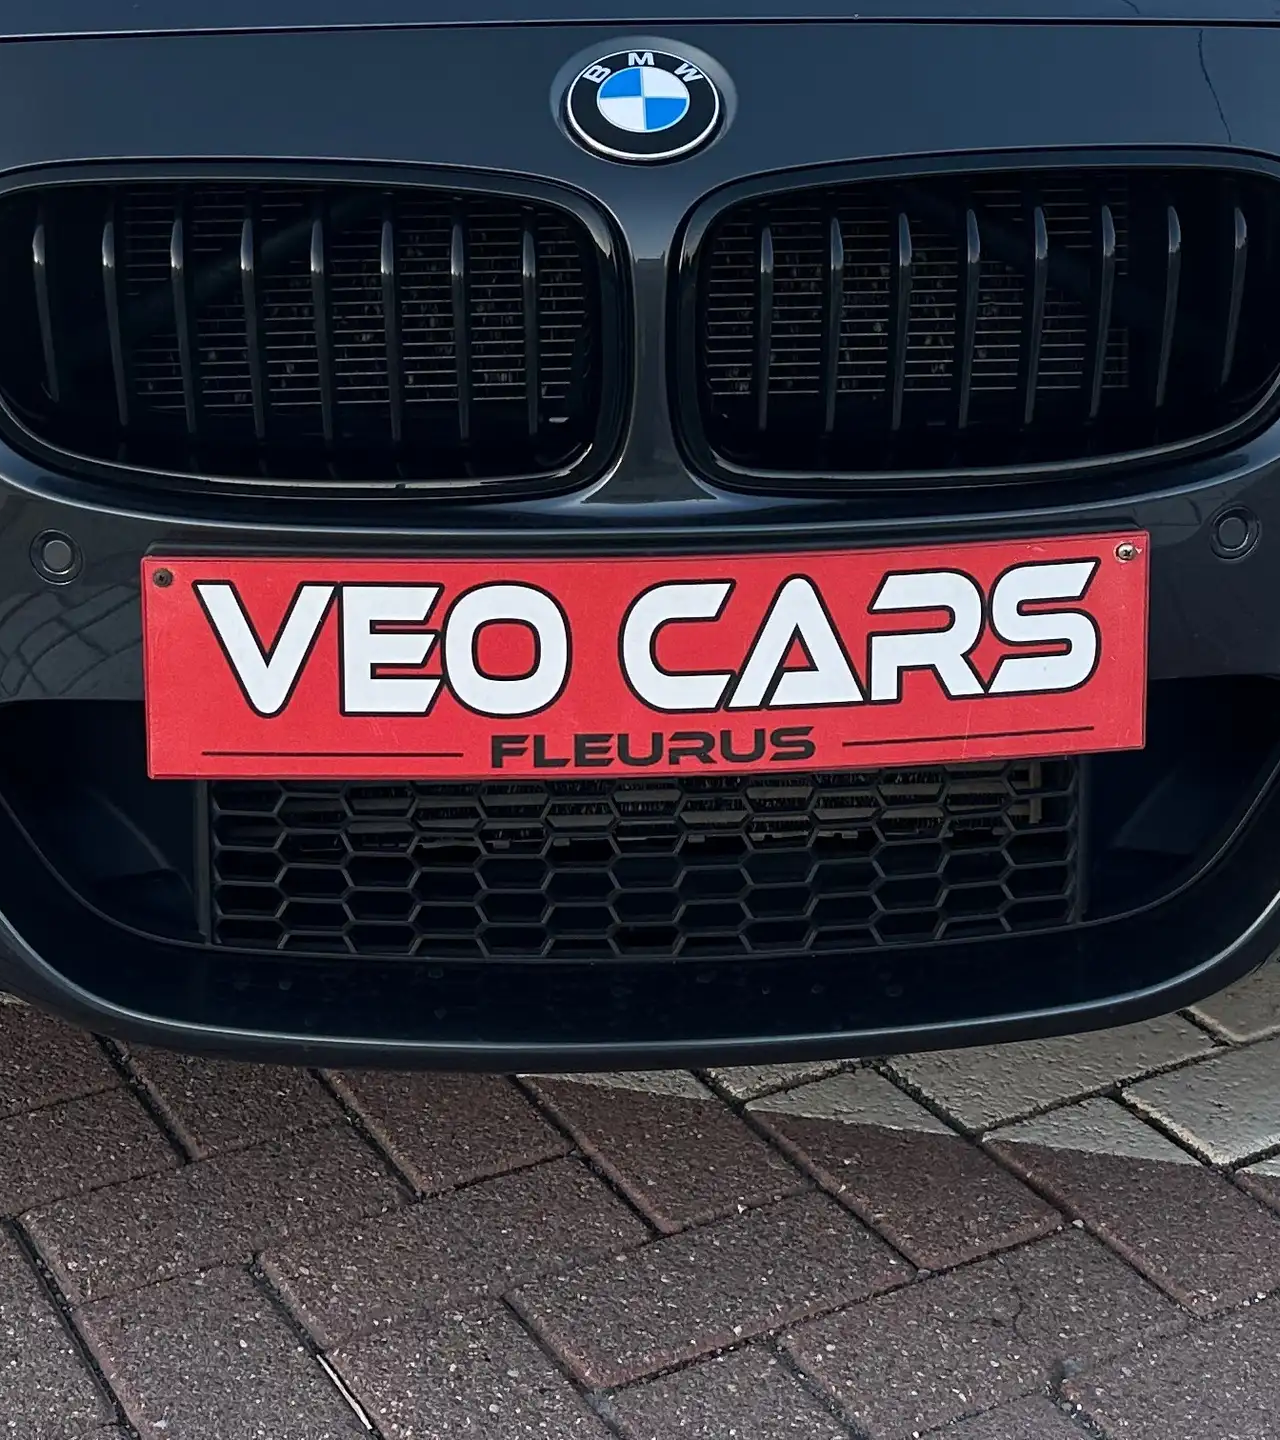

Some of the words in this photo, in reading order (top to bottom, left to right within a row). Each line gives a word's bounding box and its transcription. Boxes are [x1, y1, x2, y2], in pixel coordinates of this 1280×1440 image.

[582, 51, 704, 84] BMW
[192, 574, 573, 719] VEO
[617, 556, 1103, 716] CARS
[491, 725, 816, 769] FLEURUS
